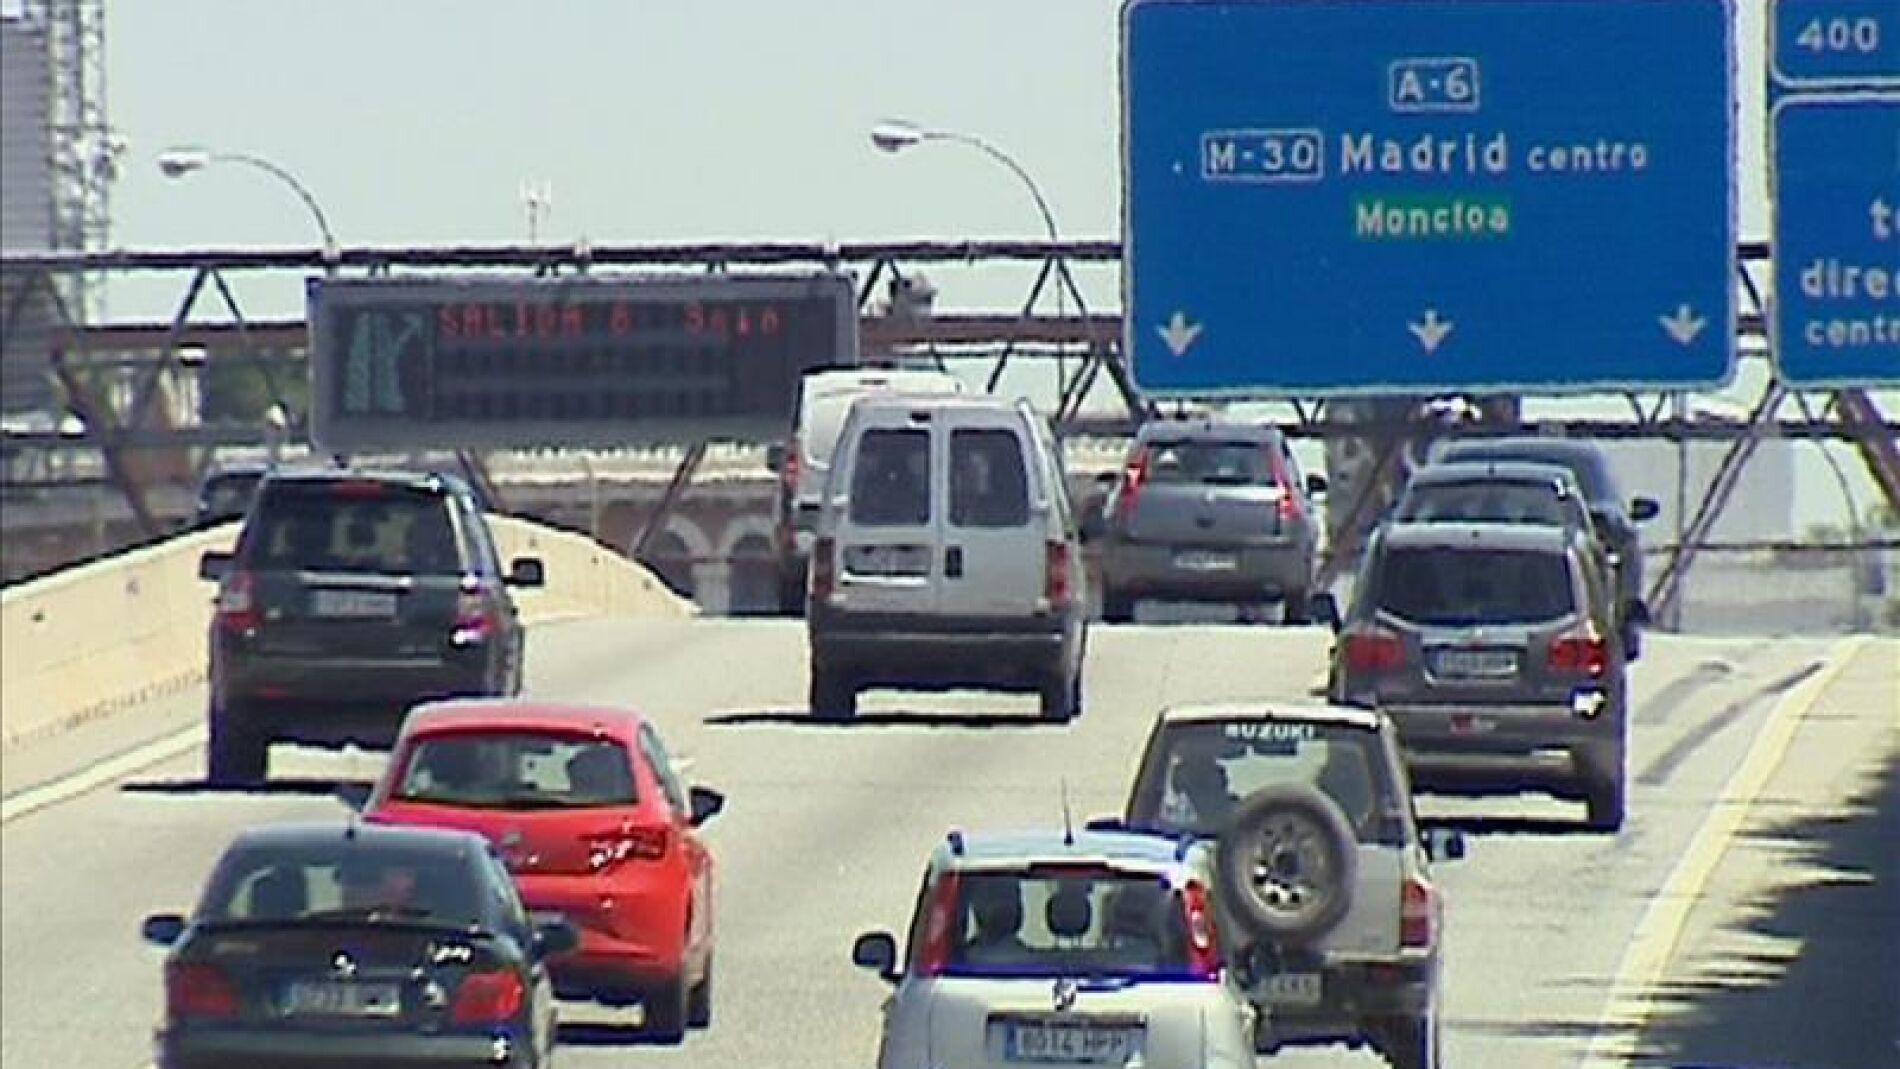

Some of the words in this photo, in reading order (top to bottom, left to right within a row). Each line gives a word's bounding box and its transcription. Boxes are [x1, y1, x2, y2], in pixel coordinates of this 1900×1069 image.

[1796, 17, 1878, 53] 400
[1208, 138, 1315, 173] M-30
[1340, 131, 1508, 174] Madrid
[1527, 138, 1649, 172] centro
[1356, 199, 1509, 237] Moncloa
[1224, 723, 1315, 740] SUZUKI
